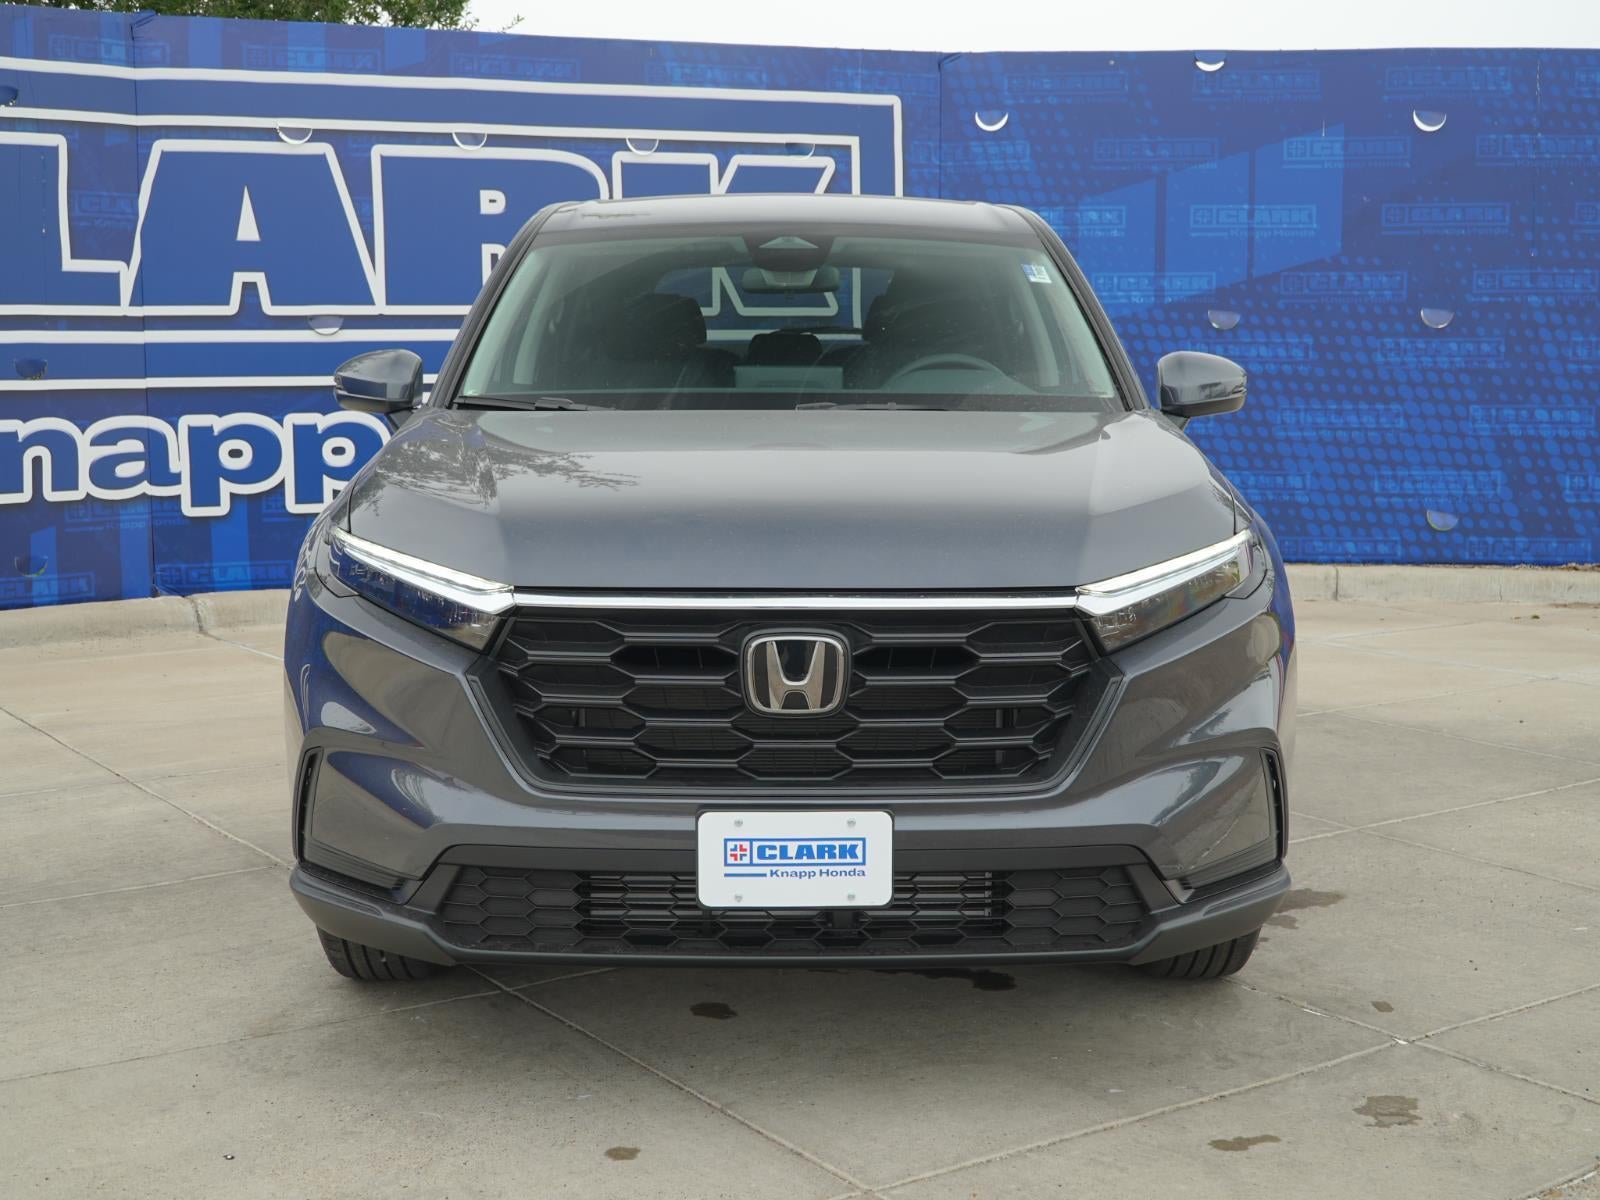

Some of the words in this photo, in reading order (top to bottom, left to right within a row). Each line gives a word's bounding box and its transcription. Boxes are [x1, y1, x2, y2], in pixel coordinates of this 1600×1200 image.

[756, 843, 860, 861] CLARK
[769, 868, 817, 880] Knapp
[819, 867, 866, 878] Honda
